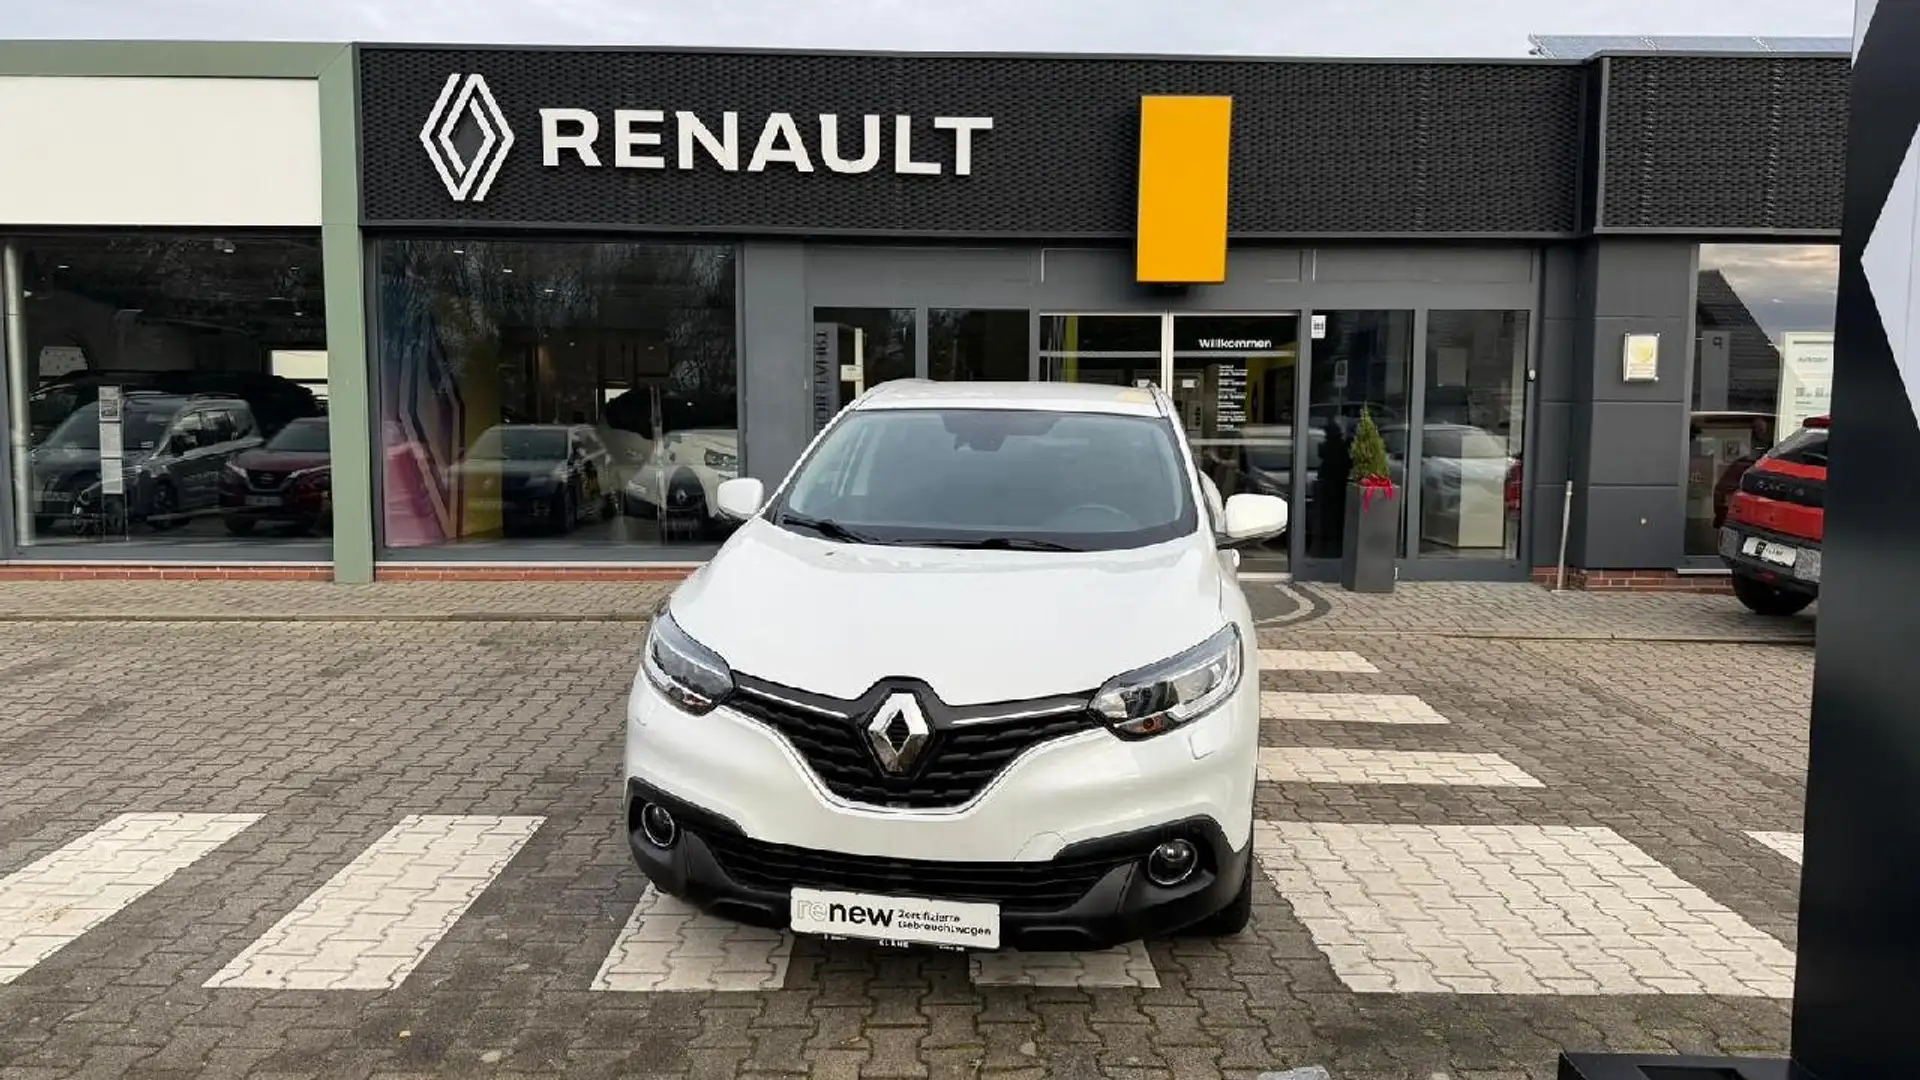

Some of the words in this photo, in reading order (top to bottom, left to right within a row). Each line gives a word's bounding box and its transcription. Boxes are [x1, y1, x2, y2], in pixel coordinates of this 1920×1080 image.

[539, 108, 993, 175] RENAULT
[1198, 339, 1272, 348] Willkommen
[797, 900, 894, 927] renew
[898, 909, 960, 922] Zertifizierte
[898, 921, 991, 936] Gebrauchtwagen
